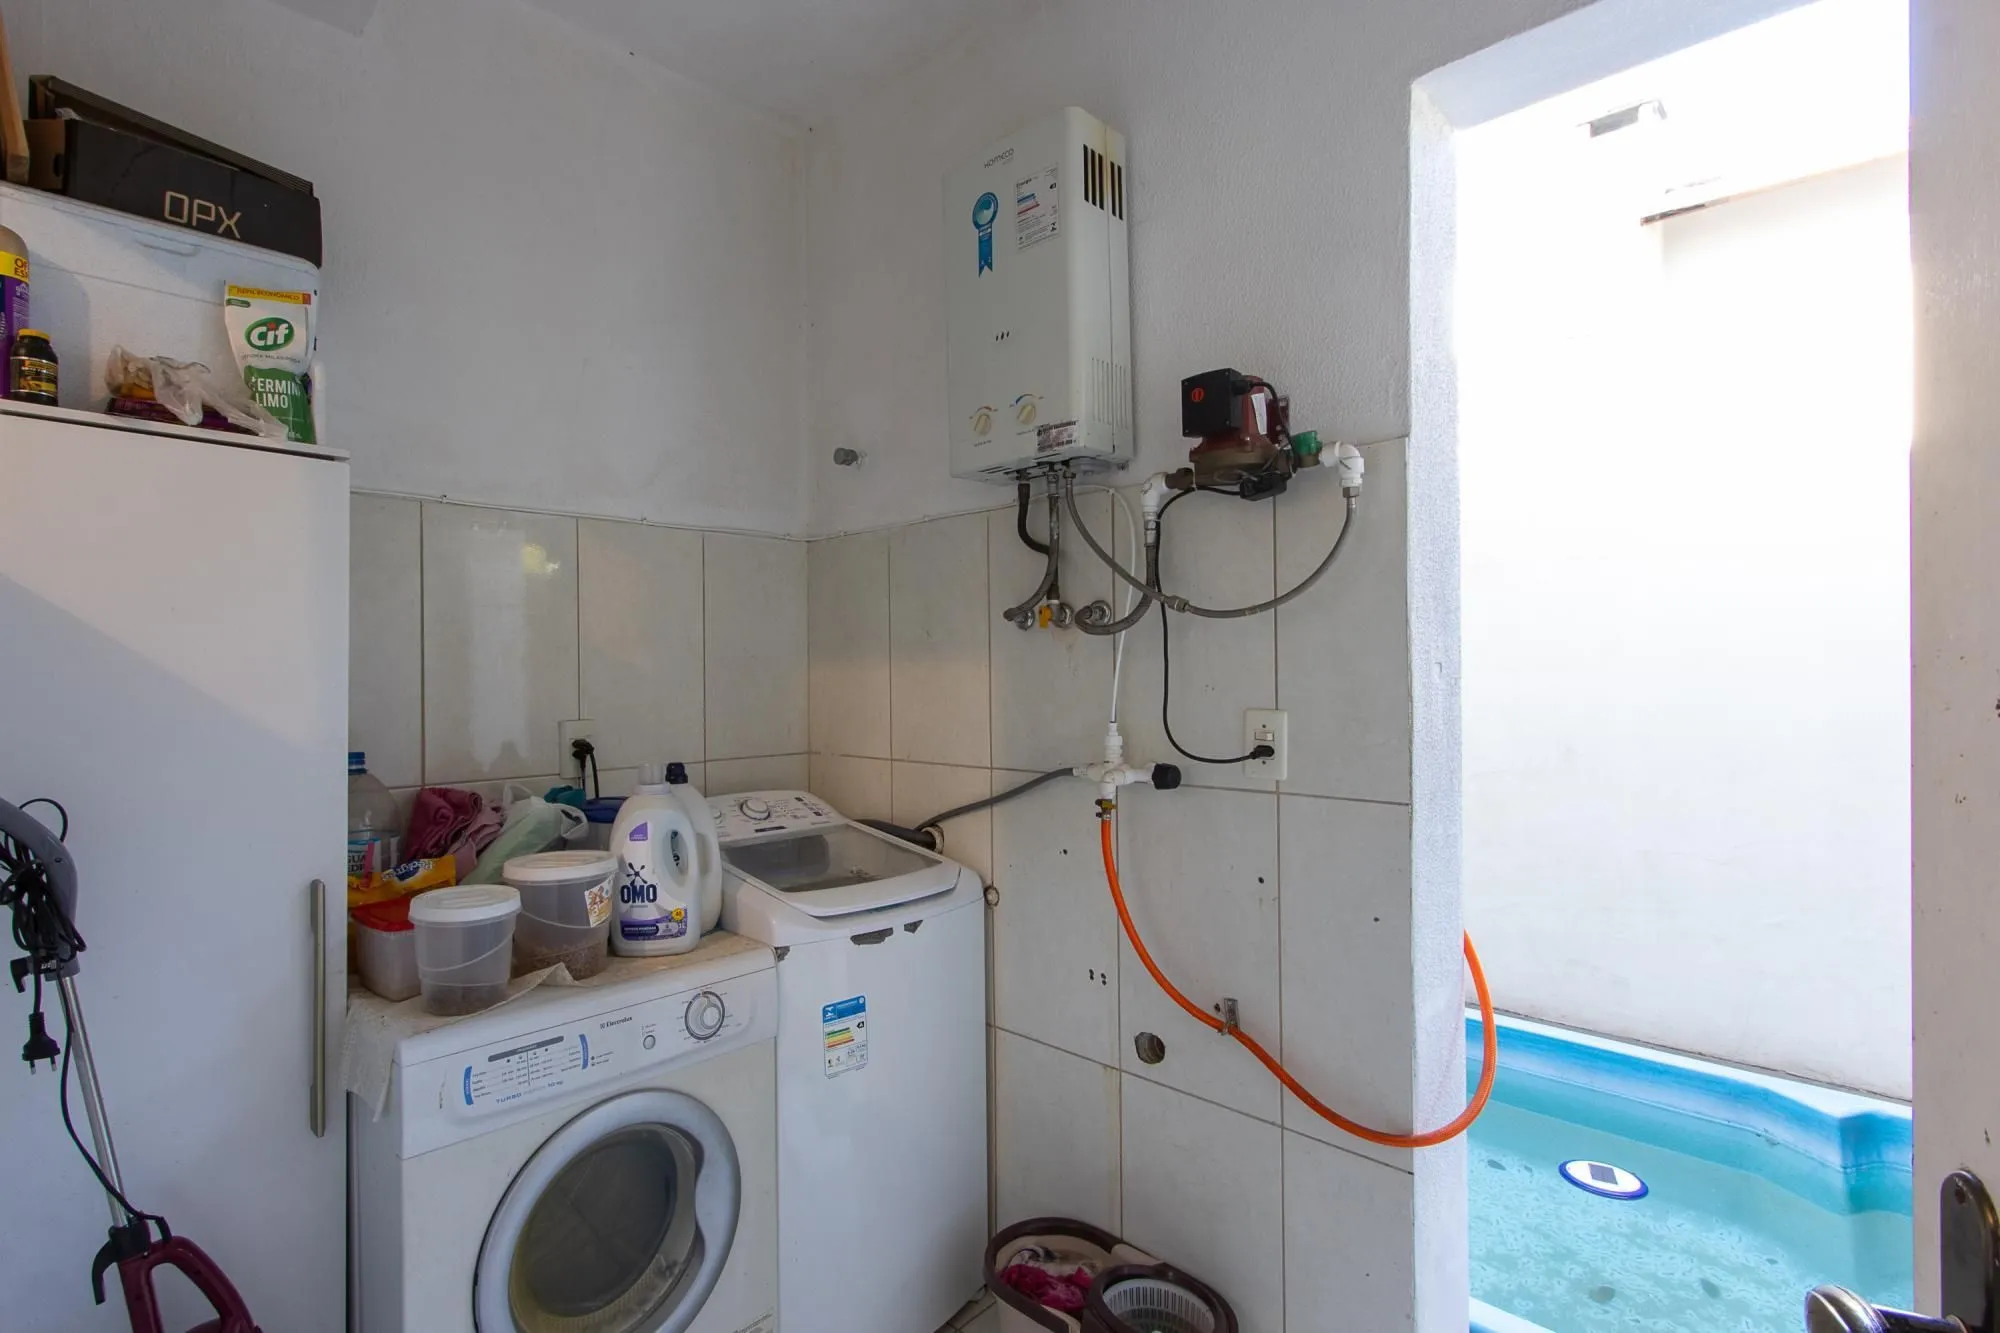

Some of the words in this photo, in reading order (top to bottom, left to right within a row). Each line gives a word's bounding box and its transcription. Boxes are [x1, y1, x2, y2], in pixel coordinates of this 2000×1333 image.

[164, 191, 242, 239] OPX
[249, 321, 289, 346] Cif
[256, 392, 288, 409] LIMO
[620, 884, 657, 904] OMO
[606, 1016, 633, 1028] Electrolux
